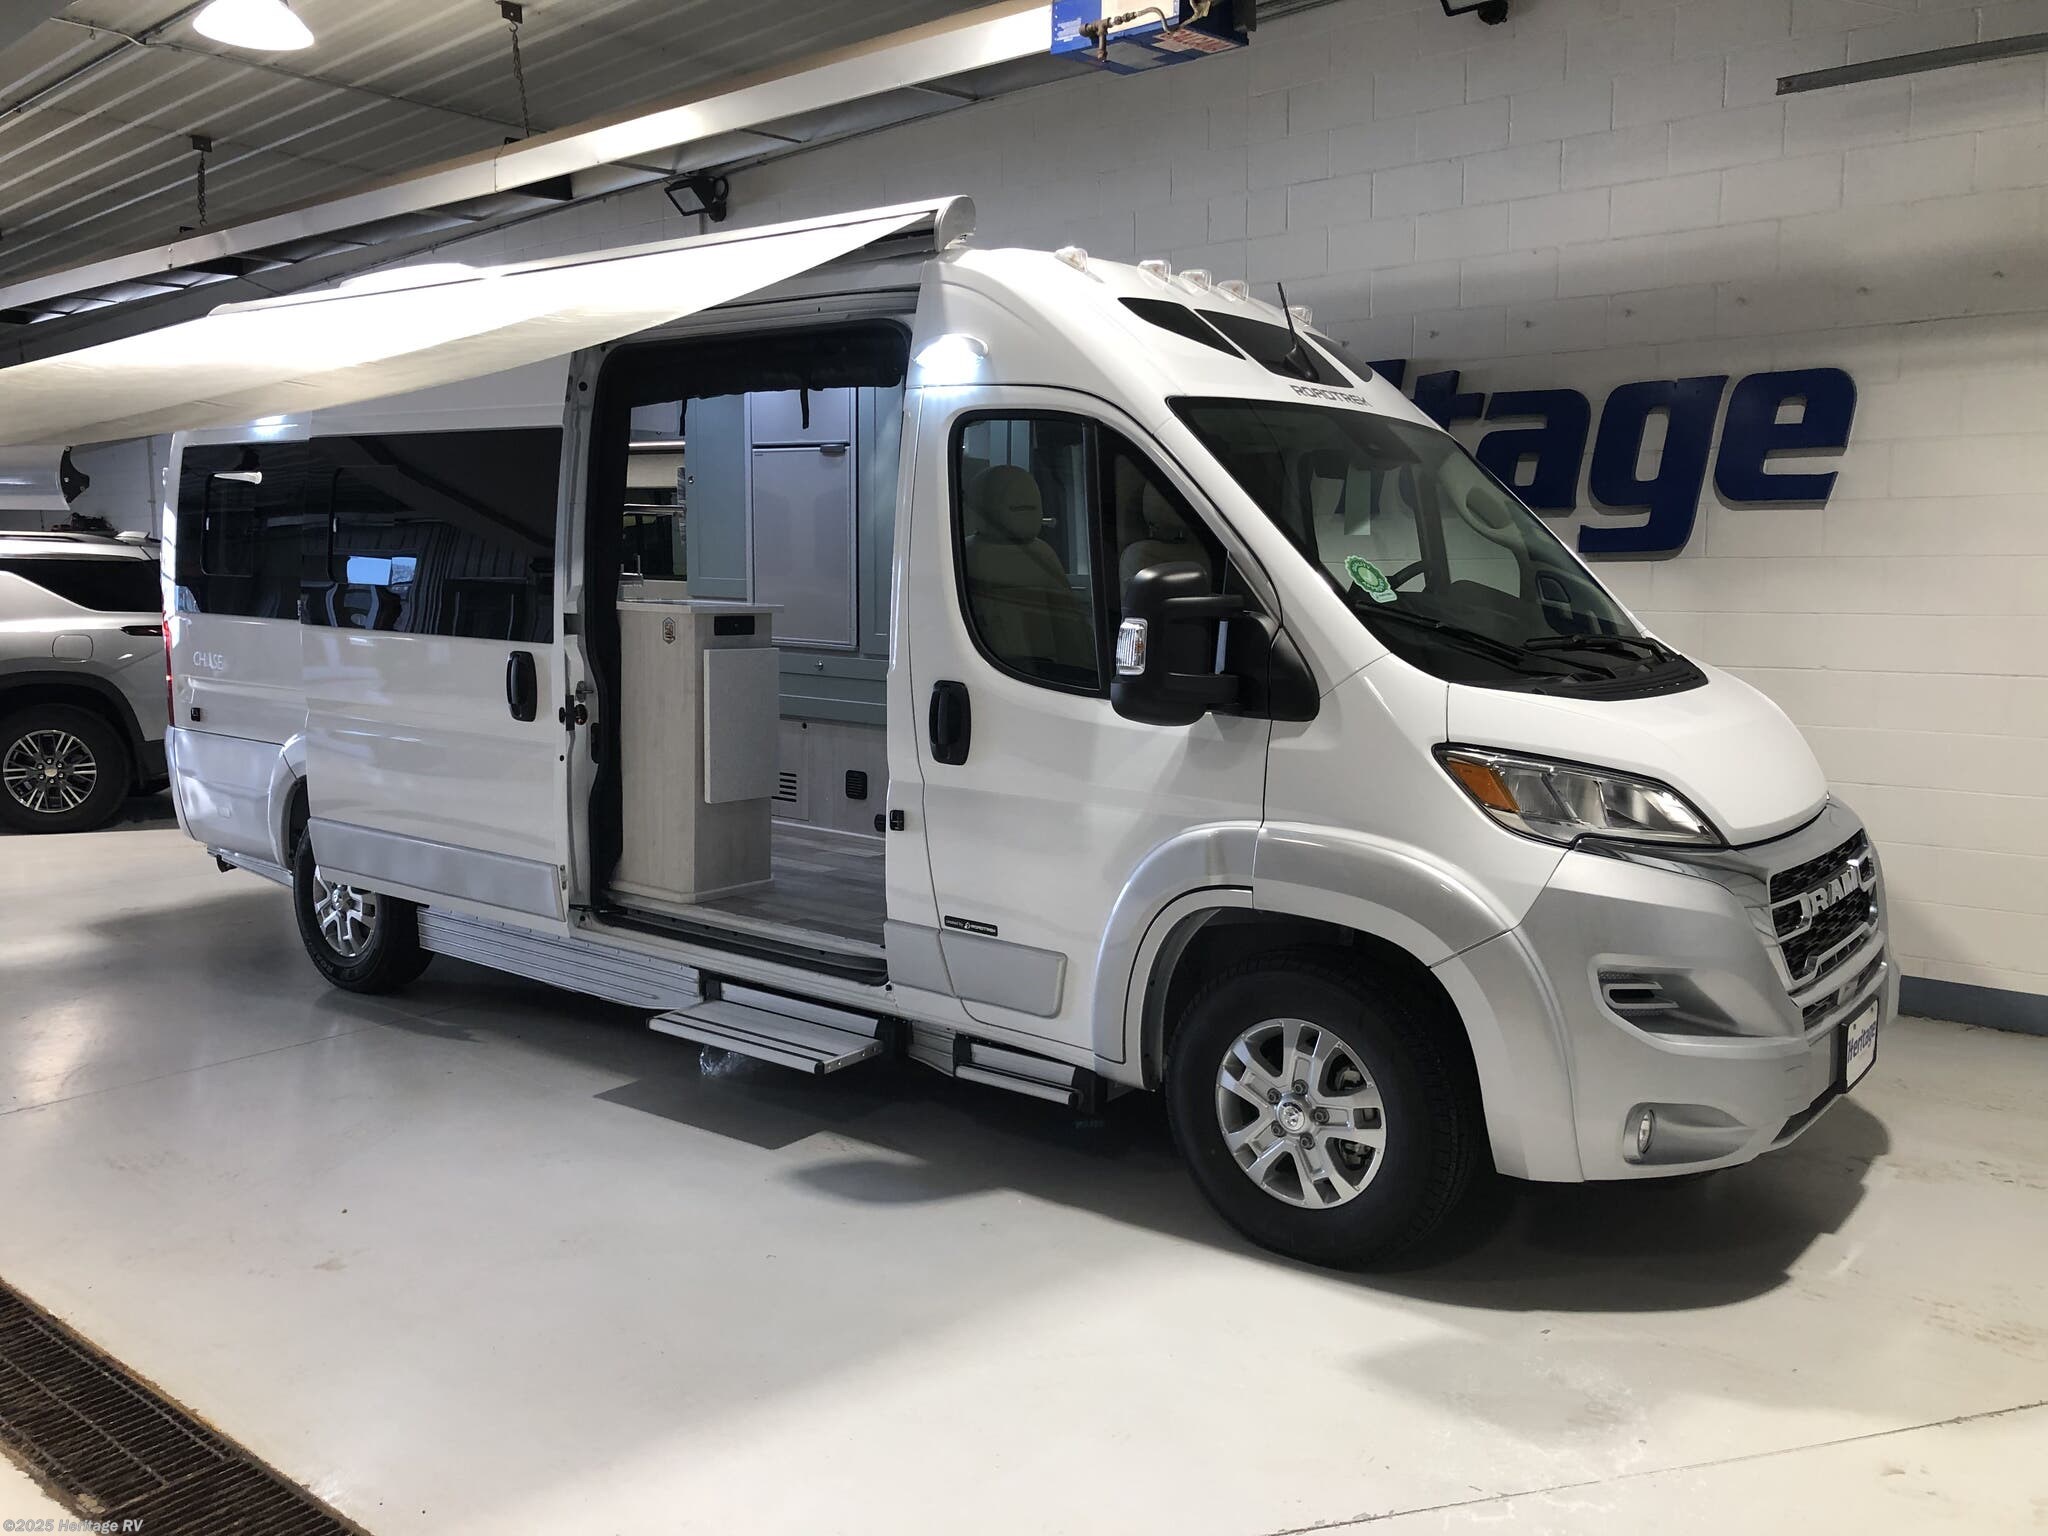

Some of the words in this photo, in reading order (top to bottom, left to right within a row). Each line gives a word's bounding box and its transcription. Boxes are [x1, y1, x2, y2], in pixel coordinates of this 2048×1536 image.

[1289, 384, 1374, 408] ROADTREK
[1366, 360, 1858, 561] tage
[192, 650, 224, 671] CHASE
[1811, 868, 1859, 916] RAM
[1847, 1020, 1877, 1063] Heritage
